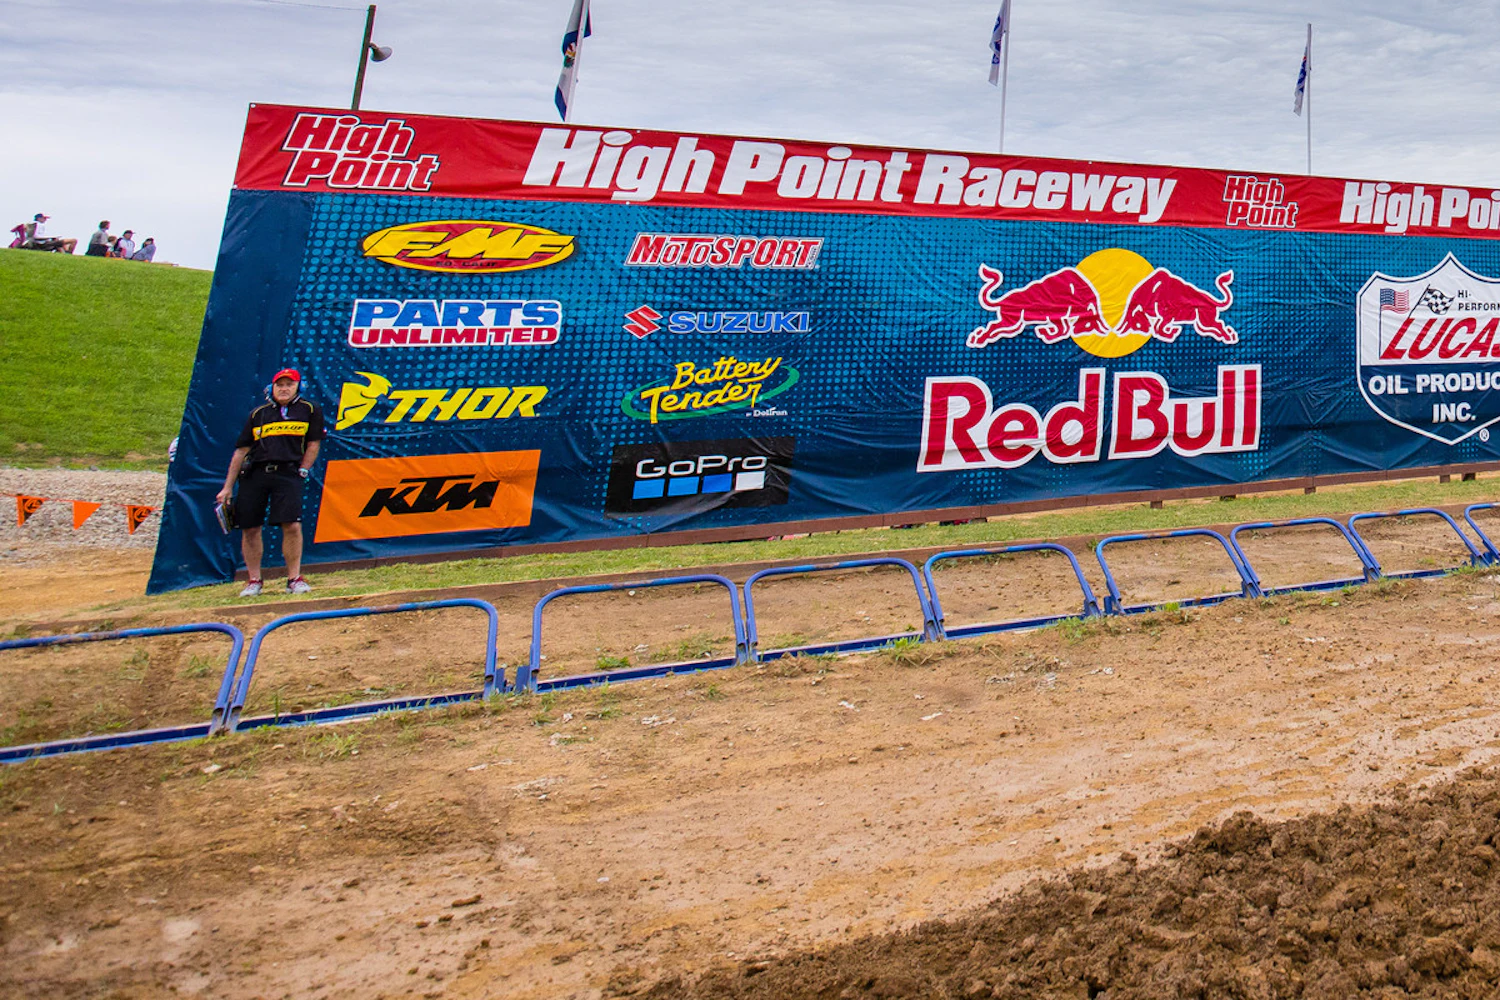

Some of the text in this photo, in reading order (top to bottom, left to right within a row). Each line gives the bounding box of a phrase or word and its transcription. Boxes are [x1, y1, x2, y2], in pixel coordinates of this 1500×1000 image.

[281, 113, 416, 157] High
[282, 150, 440, 192] Point
[522, 128, 1177, 223] High Point Raceway
[1223, 175, 1285, 204] High
[1226, 201, 1299, 228] Point
[1340, 181, 1434, 234] High
[363, 227, 575, 260] FMF
[353, 301, 560, 327] PARTS
[668, 311, 810, 333] SUZUKI
[351, 327, 558, 346] UNLIMITED
[671, 356, 782, 390] Battery
[1368, 375, 1408, 395] OIL
[384, 386, 549, 423] THOR
[641, 382, 762, 424] Tender
[917, 364, 1262, 473] Red Bull
[1432, 402, 1476, 423] INC.
[636, 455, 768, 479] GoPro
[358, 474, 500, 518] KTM
